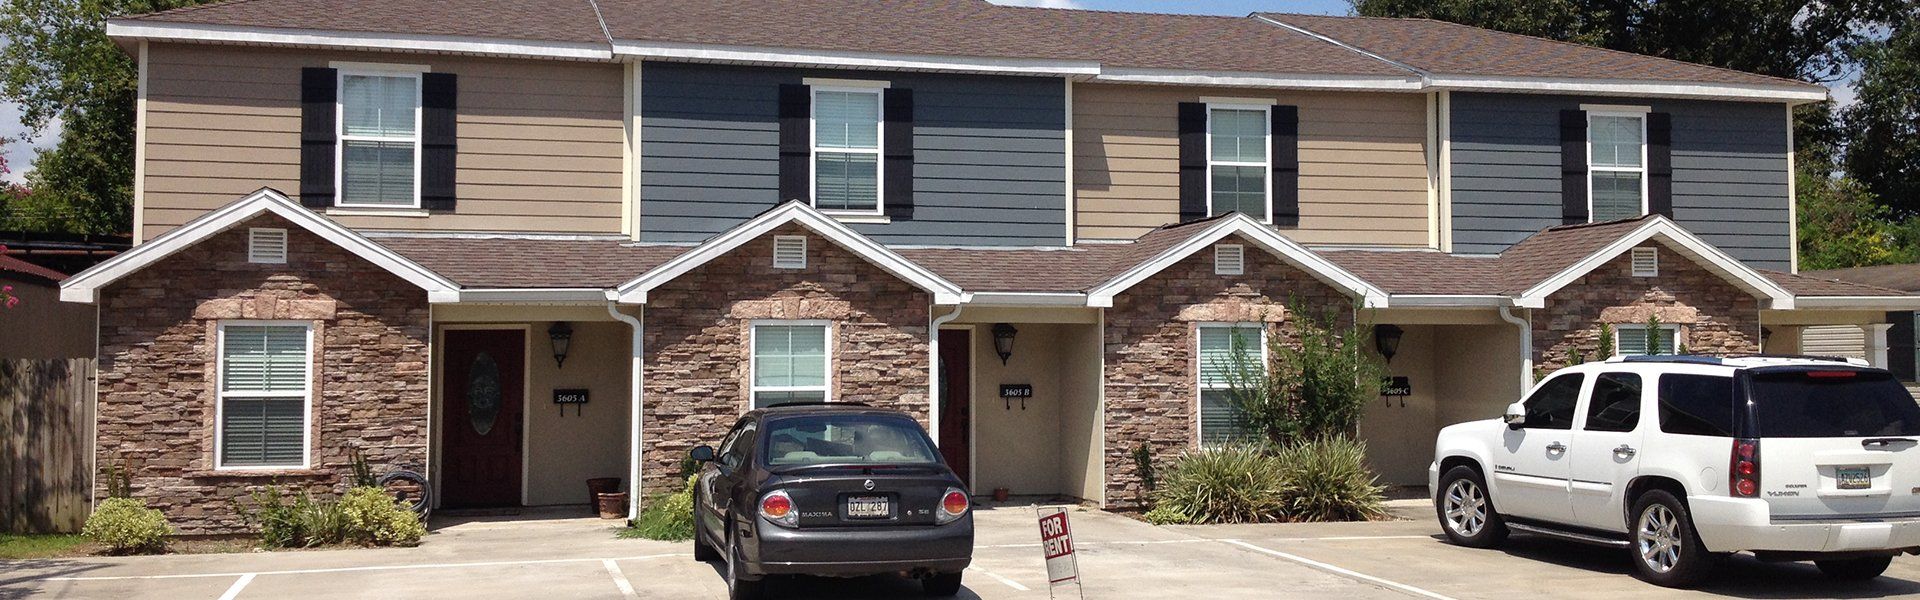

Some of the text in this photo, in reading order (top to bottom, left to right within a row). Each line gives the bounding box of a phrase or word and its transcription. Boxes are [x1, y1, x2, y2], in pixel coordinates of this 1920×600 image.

[1403, 387, 1409, 395] C
[578, 394, 585, 402] A
[871, 501, 887, 512] 287
[1041, 516, 1062, 537] FOR
[1043, 535, 1069, 556] RENT
